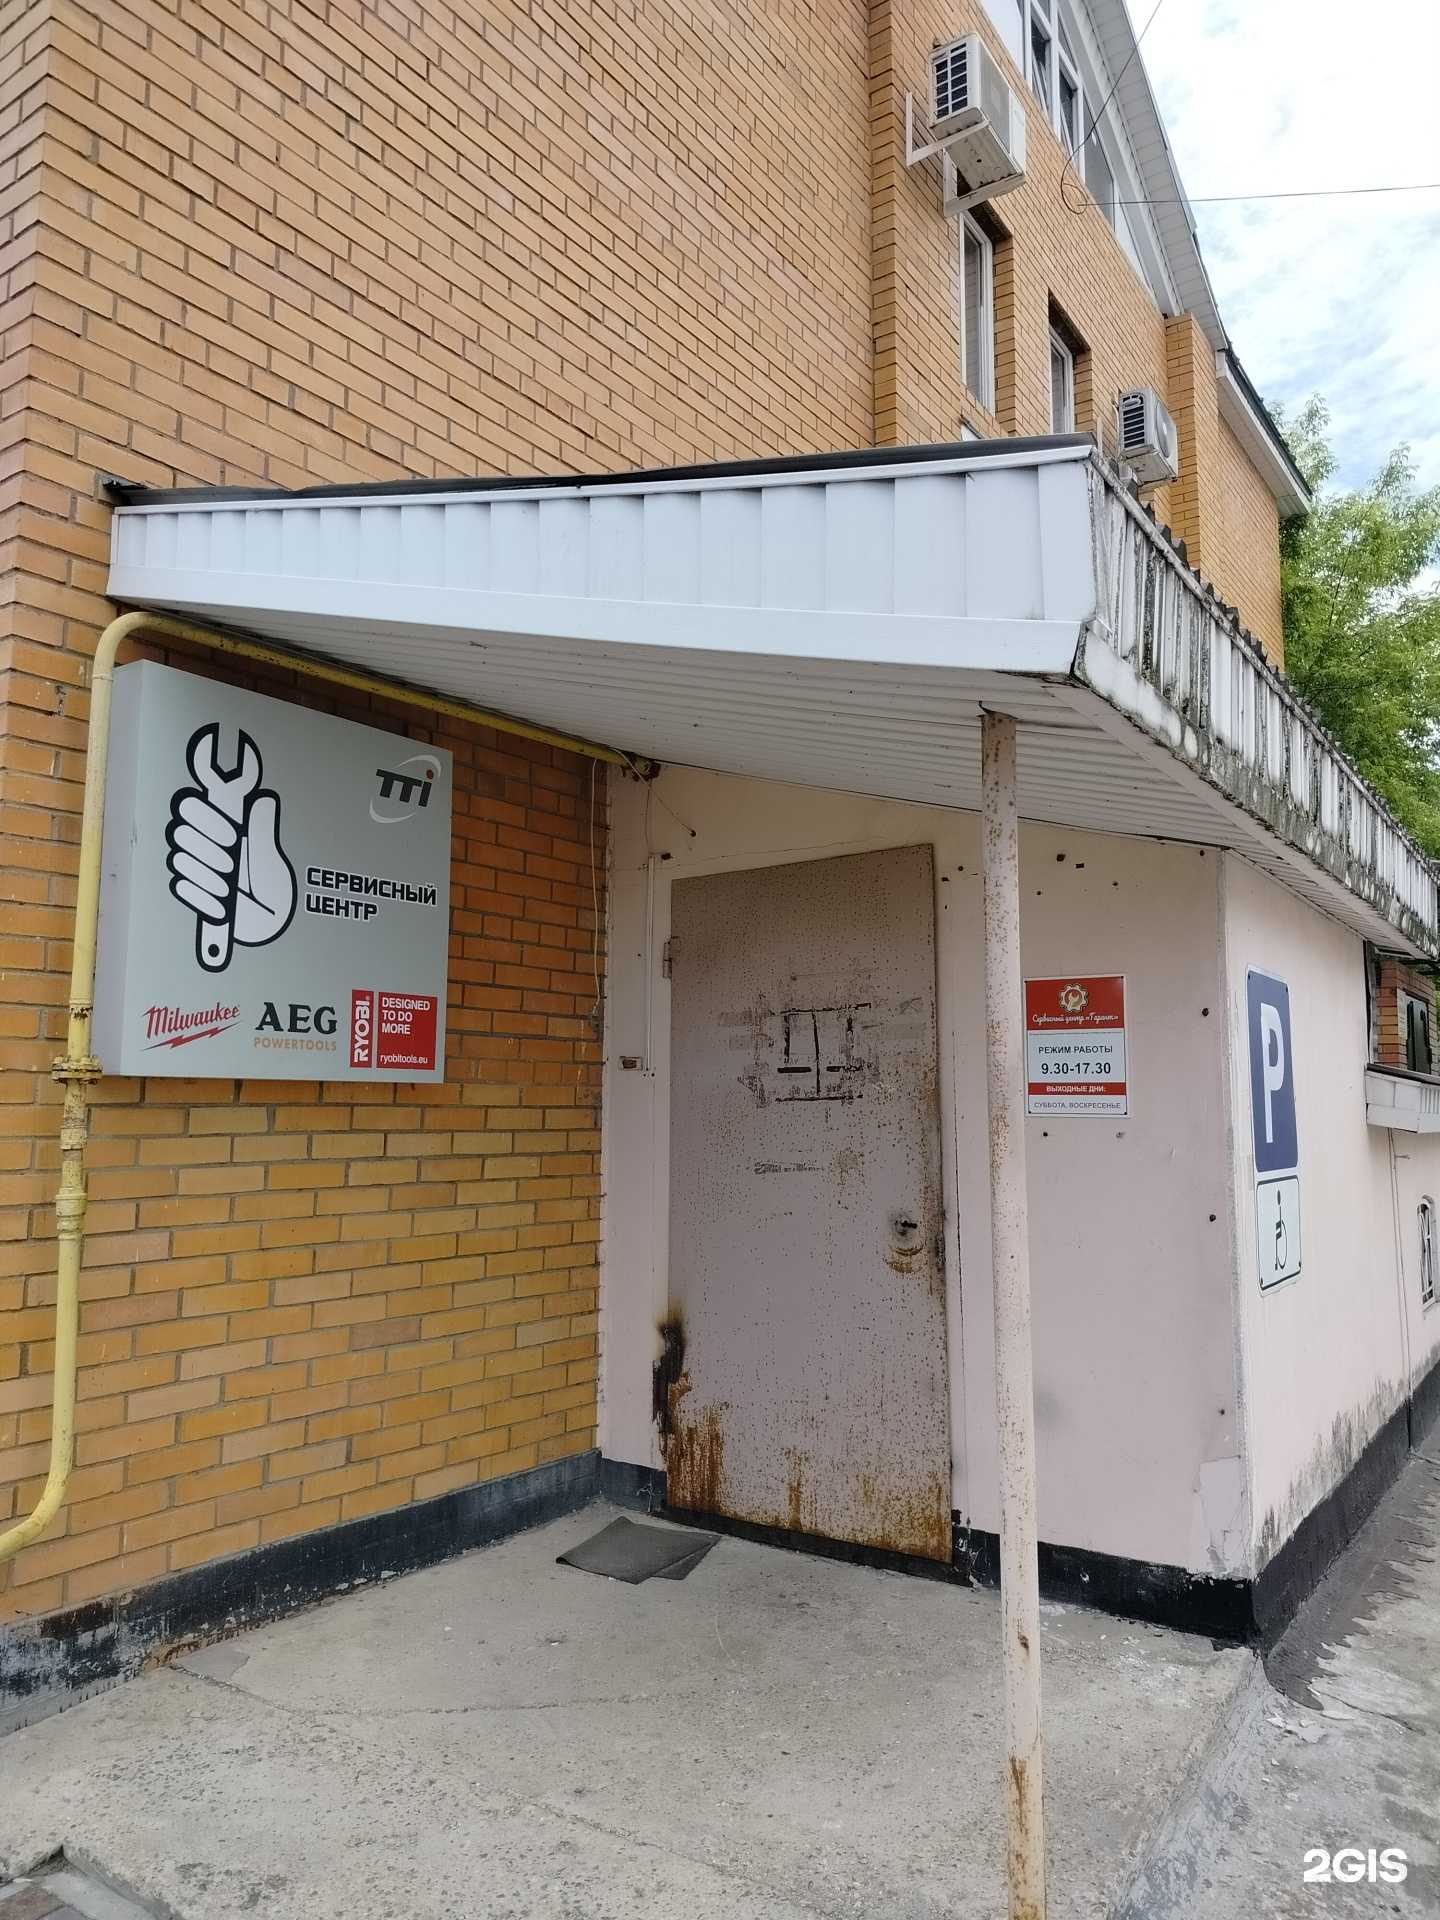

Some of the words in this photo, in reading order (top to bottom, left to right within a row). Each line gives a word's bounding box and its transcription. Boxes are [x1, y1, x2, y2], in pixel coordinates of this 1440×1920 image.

[306, 866, 437, 906] СЕРВИСНЫЙ
[305, 893, 378, 921] ЦЕНТР
[381, 997, 430, 1011] DESIGNED
[142, 1002, 240, 1039] Milwaukee
[255, 1001, 337, 1035] AEG
[382, 1010, 396, 1020] TO
[397, 1011, 413, 1022] DO
[354, 1000, 370, 1062] RYOBI
[381, 1022, 411, 1034] MORE
[254, 1036, 337, 1052] POWERTOOLS
[1038, 1046, 1071, 1054] РЕЖИМ
[1074, 1045, 1113, 1054] РАБОТЫ
[380, 1053, 428, 1064] ryobitools.eu
[1041, 1062, 1111, 1075] 9.30-17.30
[1046, 1085, 1087, 1093] ВЫХОДНЫЕ
[1069, 1102, 1121, 1110] ВОСКРЕСЕНЬЕ
